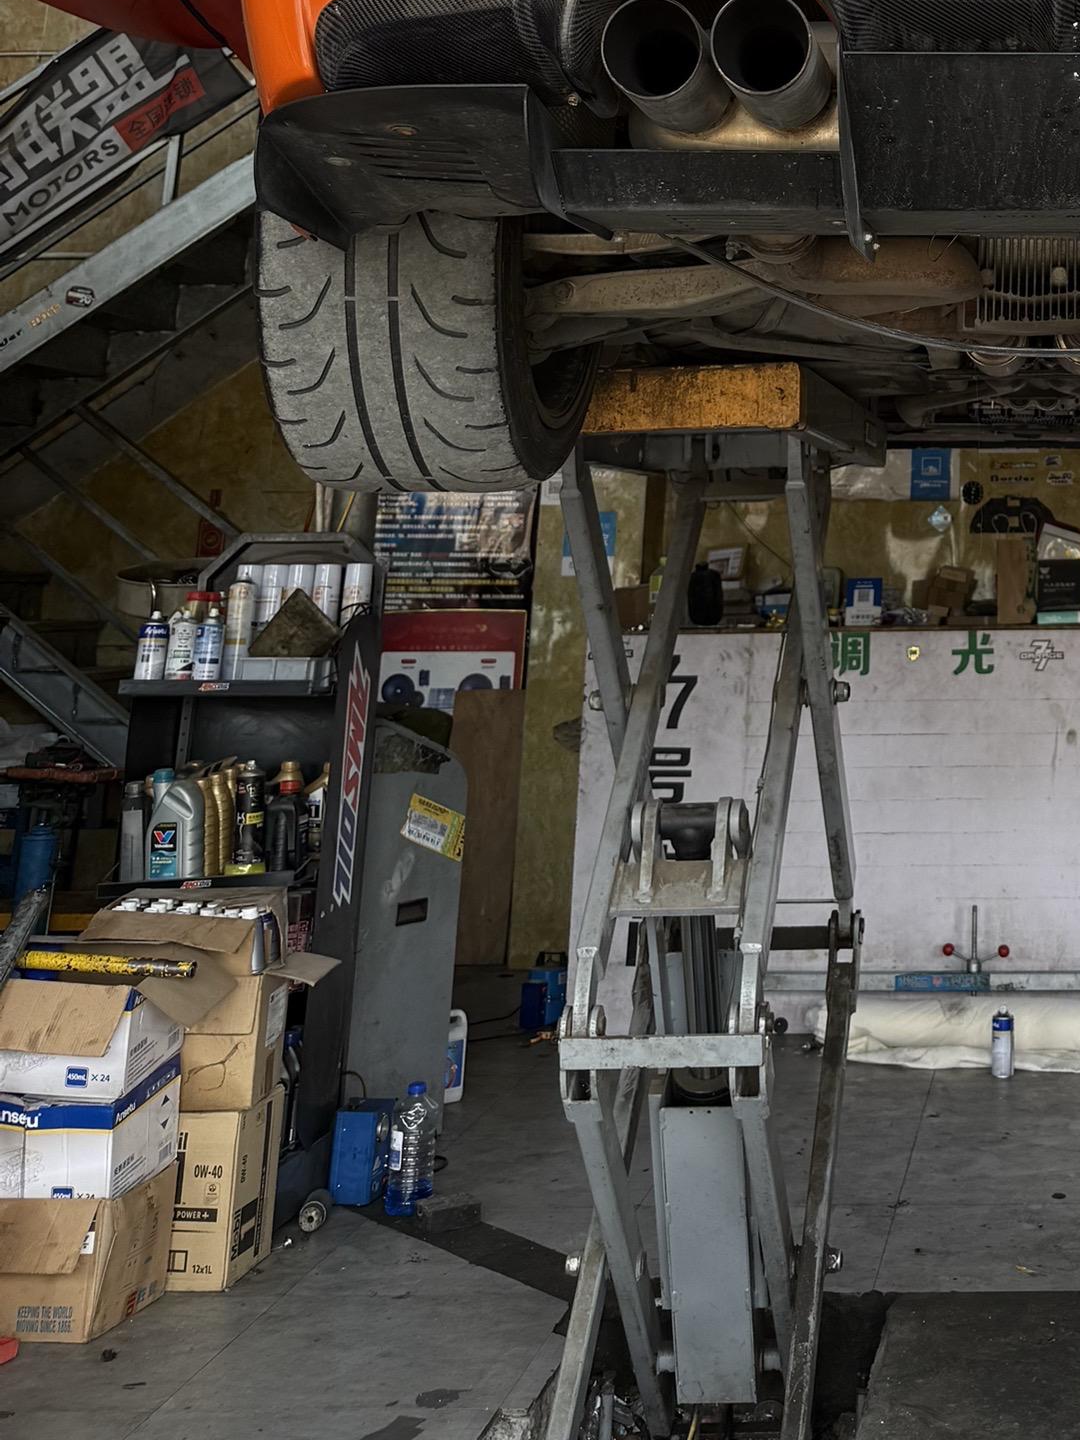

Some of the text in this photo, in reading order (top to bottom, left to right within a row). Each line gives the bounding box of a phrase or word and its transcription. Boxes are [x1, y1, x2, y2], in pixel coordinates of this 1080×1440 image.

[5, 137, 120, 227] MOTORS
[952, 630, 995, 676] 光
[100, 1073, 110, 1082] 24
[194, 1164, 223, 1179] 0W-40
[176, 1210, 210, 1220] POWER+
[192, 1264, 213, 1275] 12x1L
[17, 1306, 73, 1319] KEEPING THE WORLD
[16, 1319, 38, 1333] MOVING
[40, 1320, 57, 1333] SINCE
